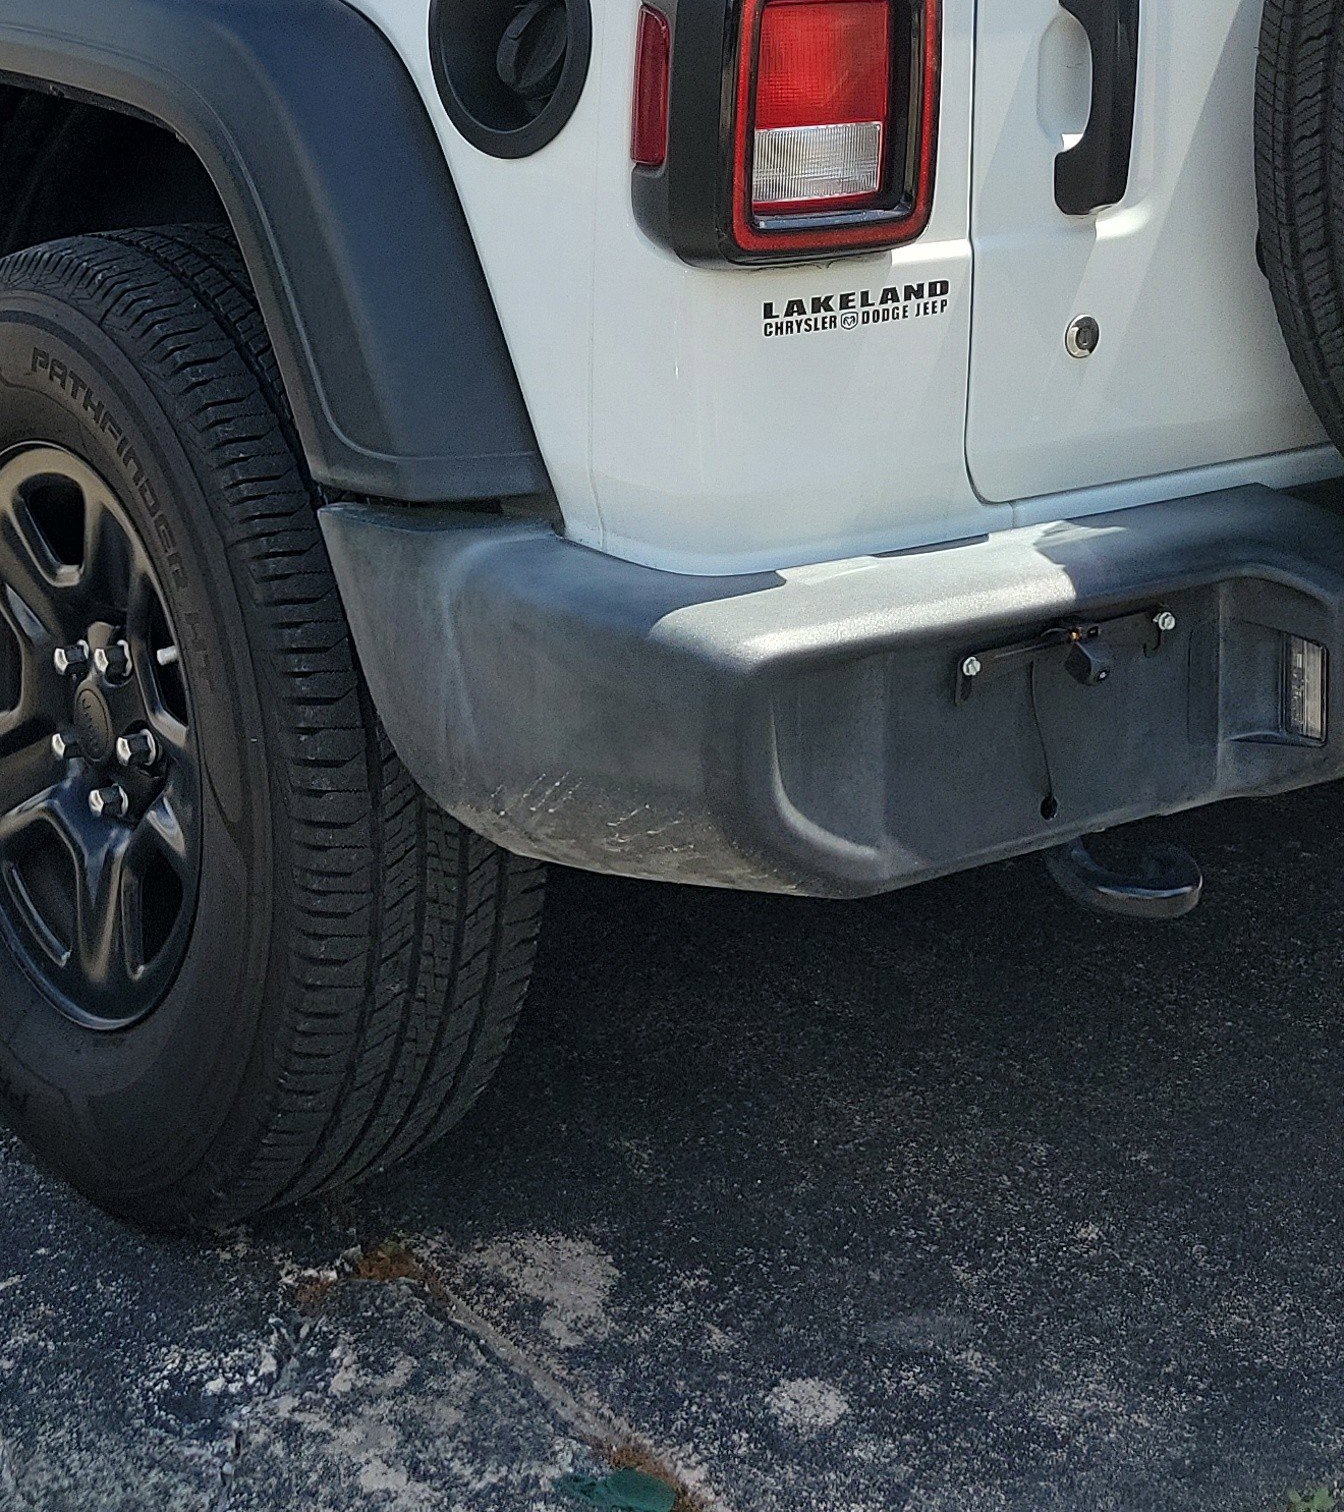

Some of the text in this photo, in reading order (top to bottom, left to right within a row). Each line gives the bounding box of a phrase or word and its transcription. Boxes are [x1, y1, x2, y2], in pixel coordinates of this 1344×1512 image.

[763, 280, 949, 319] LAKELAND
[764, 299, 948, 336] CHRYSLER DODGE JEEP
